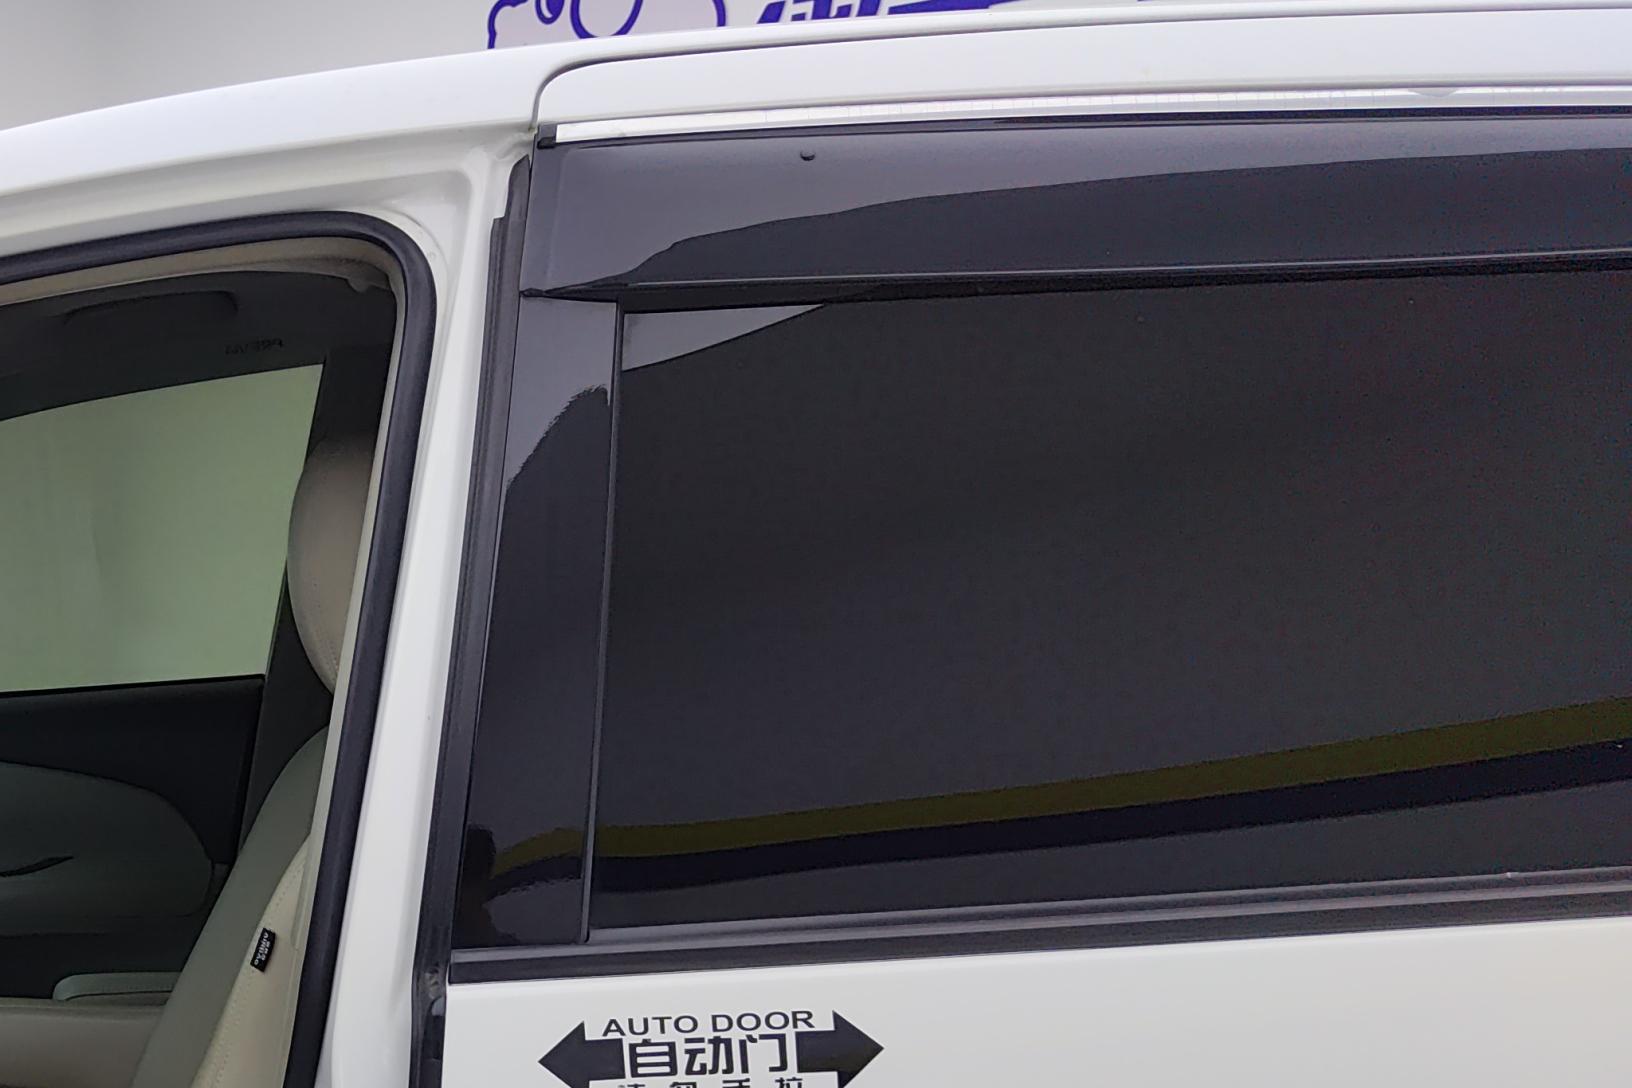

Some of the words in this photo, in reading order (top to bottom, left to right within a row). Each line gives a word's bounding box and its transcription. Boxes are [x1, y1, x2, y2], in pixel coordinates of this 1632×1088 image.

[602, 1015, 699, 1037] AUTO
[711, 1010, 815, 1033] DOOR
[628, 1034, 788, 1079] 自动门
